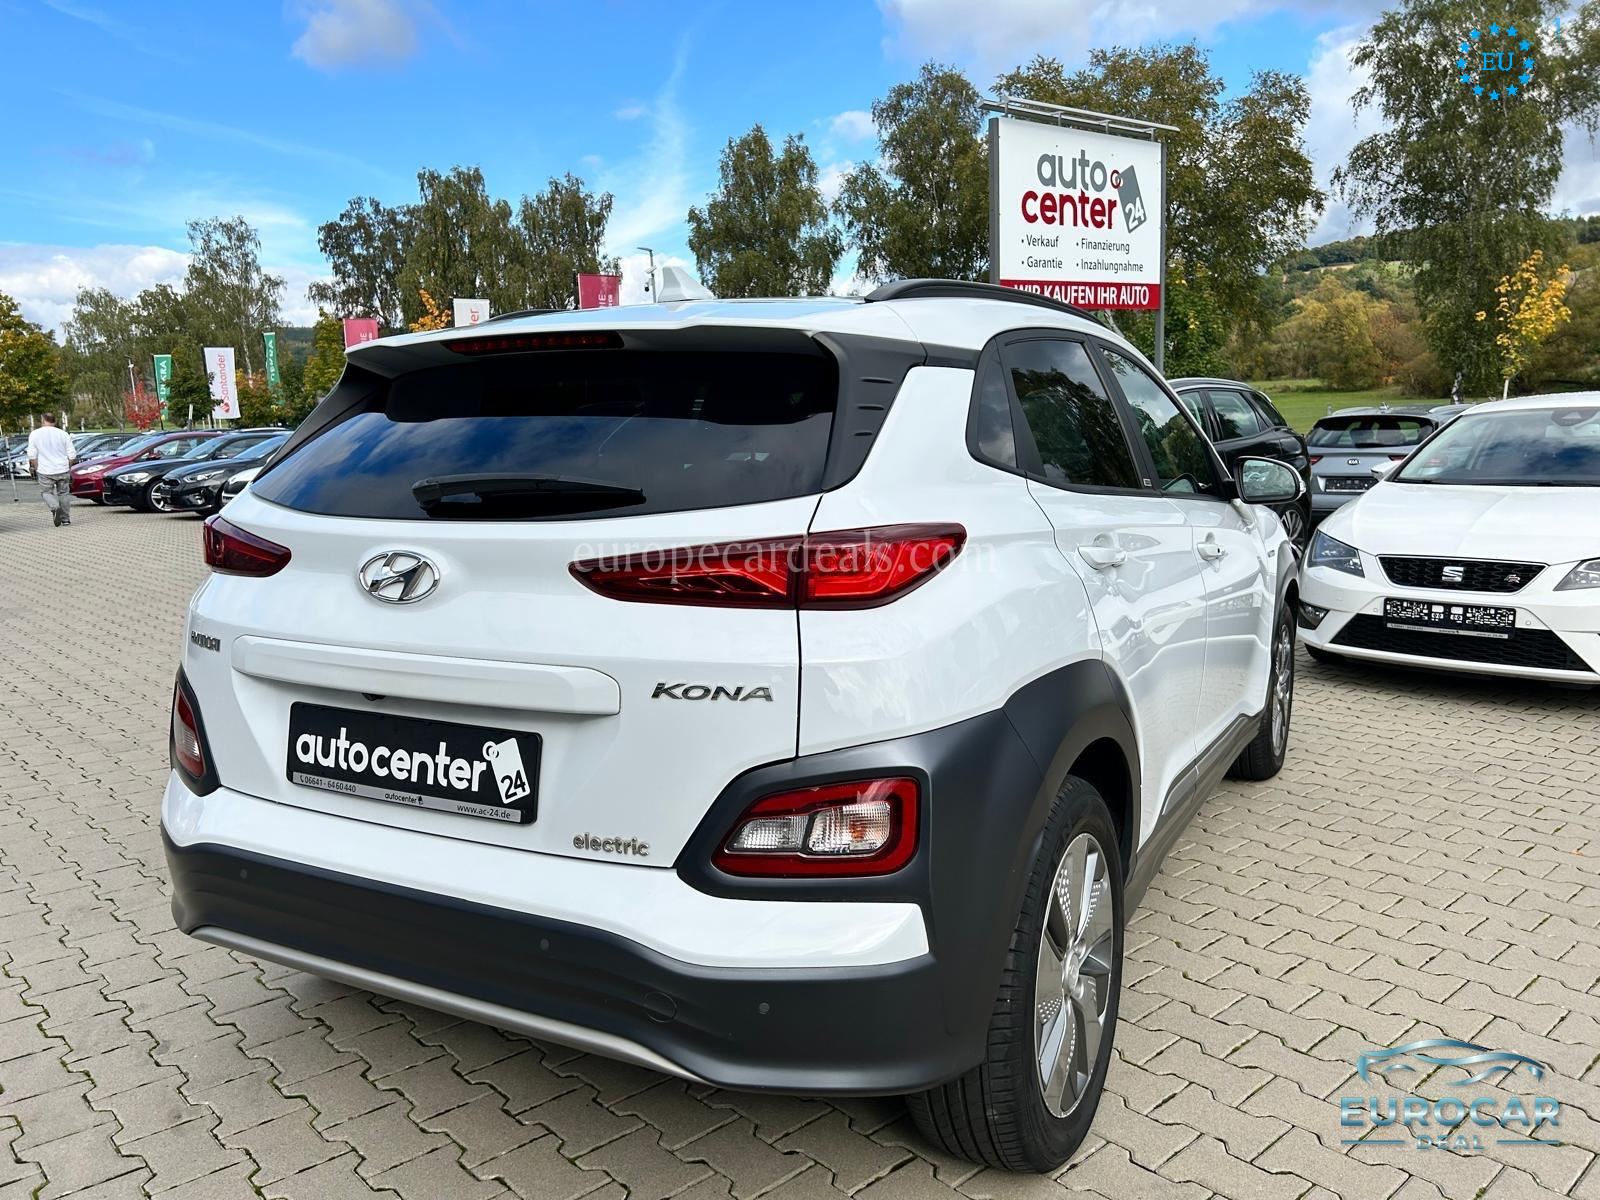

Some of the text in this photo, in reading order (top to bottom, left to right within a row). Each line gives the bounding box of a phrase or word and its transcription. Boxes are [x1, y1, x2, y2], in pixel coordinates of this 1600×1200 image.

[1037, 150, 1107, 192] auto
[1021, 189, 1117, 229] center
[1125, 197, 1145, 231] 24
[1026, 234, 1059, 248] Verkauf
[1081, 238, 1130, 254] Finanzierung
[1027, 257, 1063, 269] Garantie
[1081, 259, 1143, 274] Inzahlungnahme
[1097, 287, 1117, 305] IHR
[1119, 286, 1149, 305] AUTO
[217, 354, 230, 401] Santander
[651, 682, 774, 702] KONA
[304, 776, 322, 787] 06641
[500, 769, 527, 800] 24
[384, 793, 417, 804] autocenter
[456, 803, 511, 819] www.ac-24.de
[573, 832, 649, 857] electric
